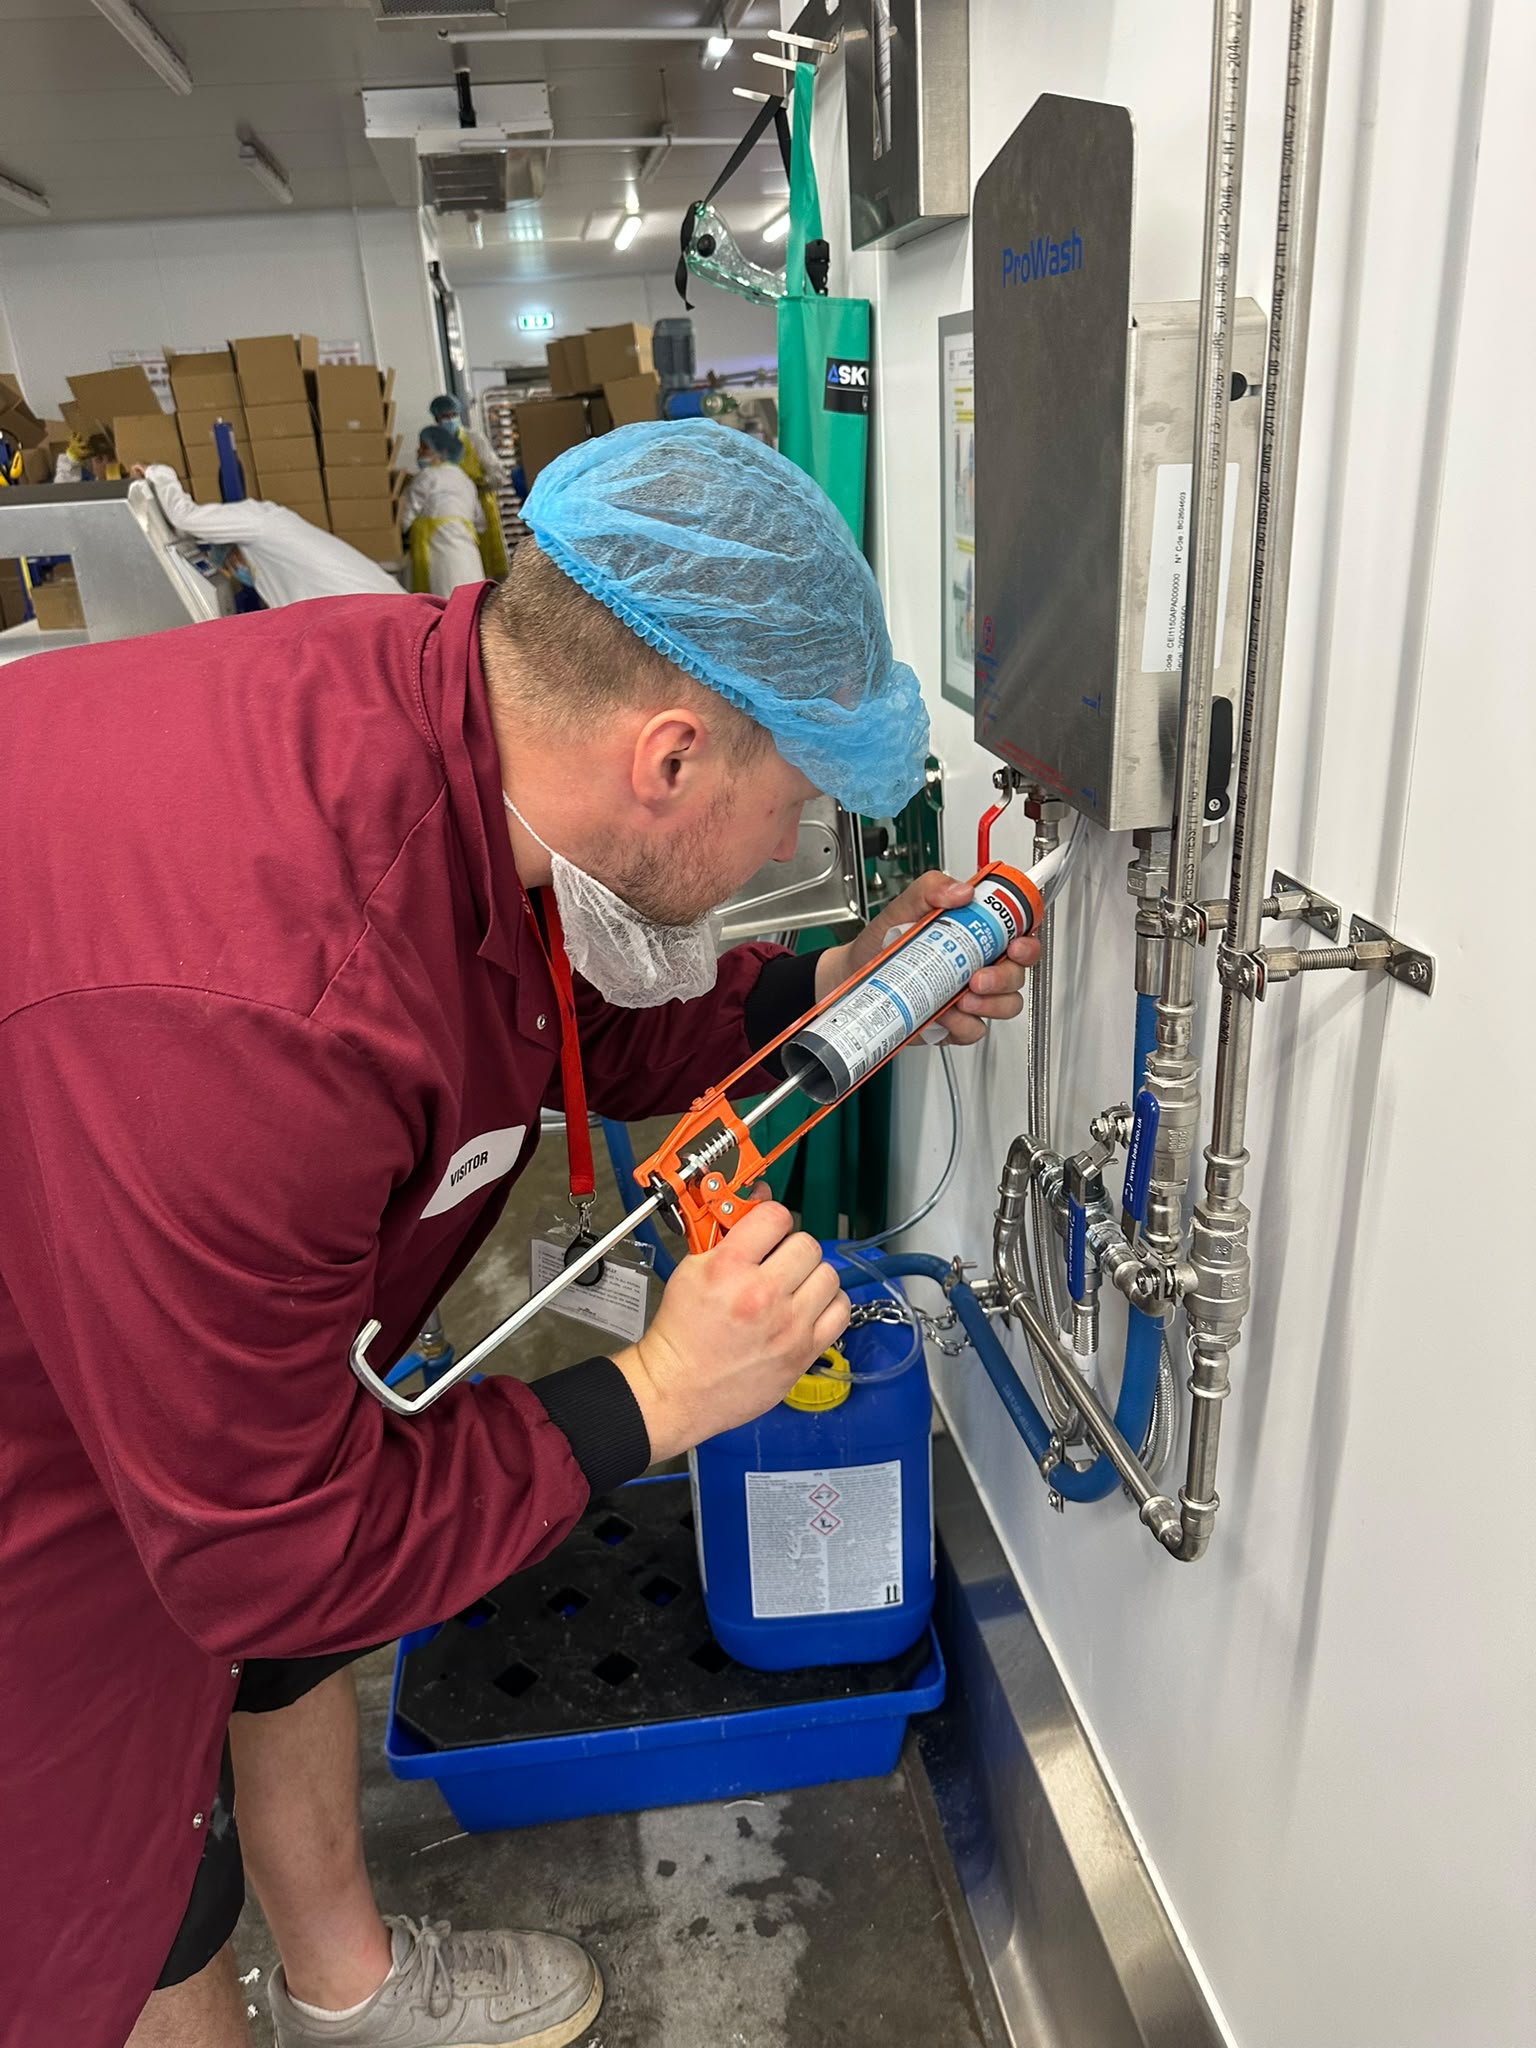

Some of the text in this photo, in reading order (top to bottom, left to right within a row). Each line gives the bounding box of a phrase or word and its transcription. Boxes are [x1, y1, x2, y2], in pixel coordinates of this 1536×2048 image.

[1002, 226, 1082, 289] ProWash
[828, 364, 869, 386] ASK
[984, 895, 1016, 941] SOUDA
[968, 919, 994, 960] Fresh
[450, 1151, 488, 1187] VISITOR
